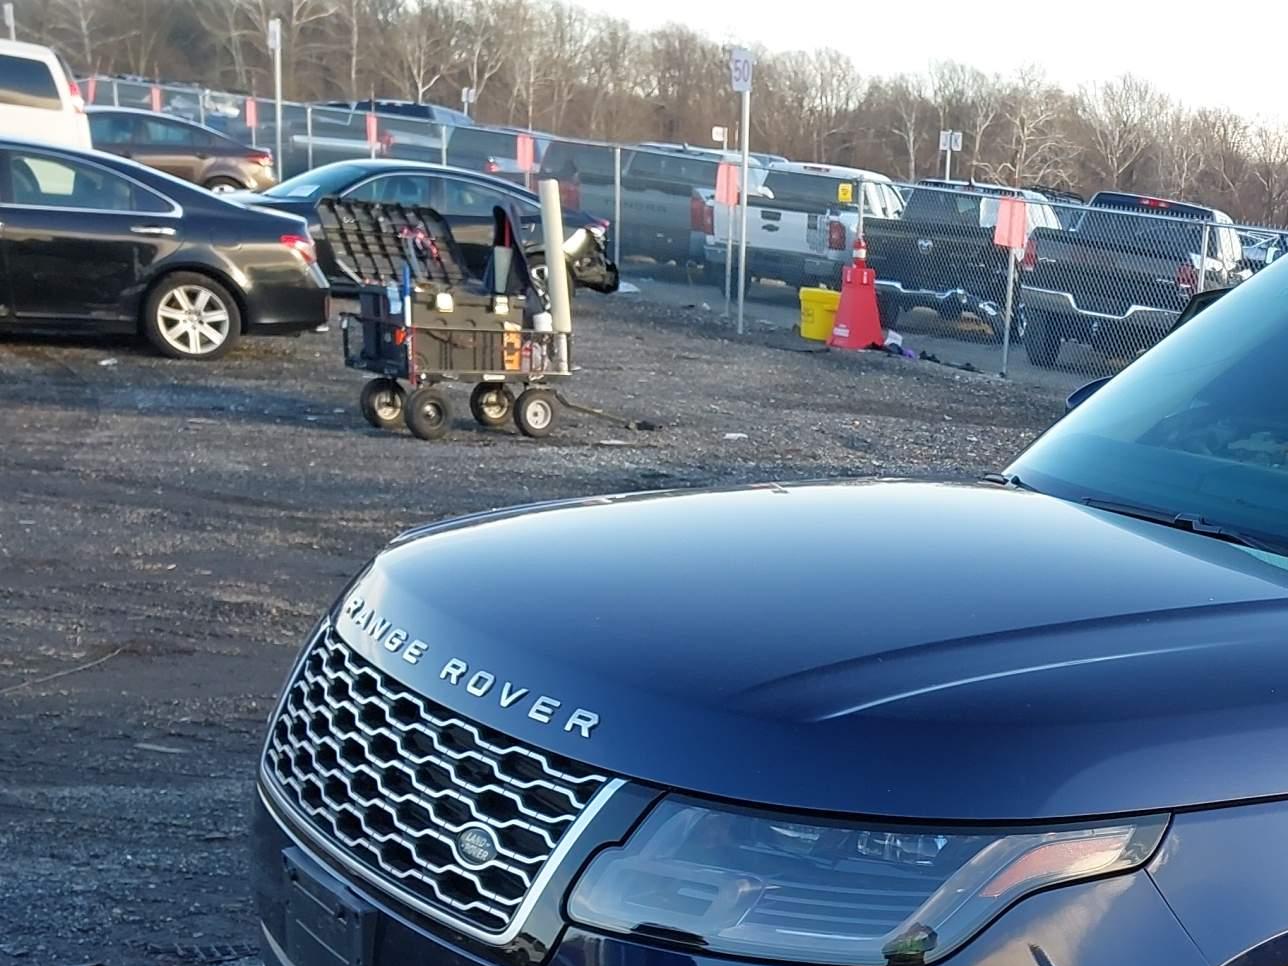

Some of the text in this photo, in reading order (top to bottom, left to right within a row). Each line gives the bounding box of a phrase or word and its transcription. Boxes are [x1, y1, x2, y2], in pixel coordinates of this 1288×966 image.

[734, 59, 750, 82] 50
[346, 598, 601, 739] RANGE ROVER
